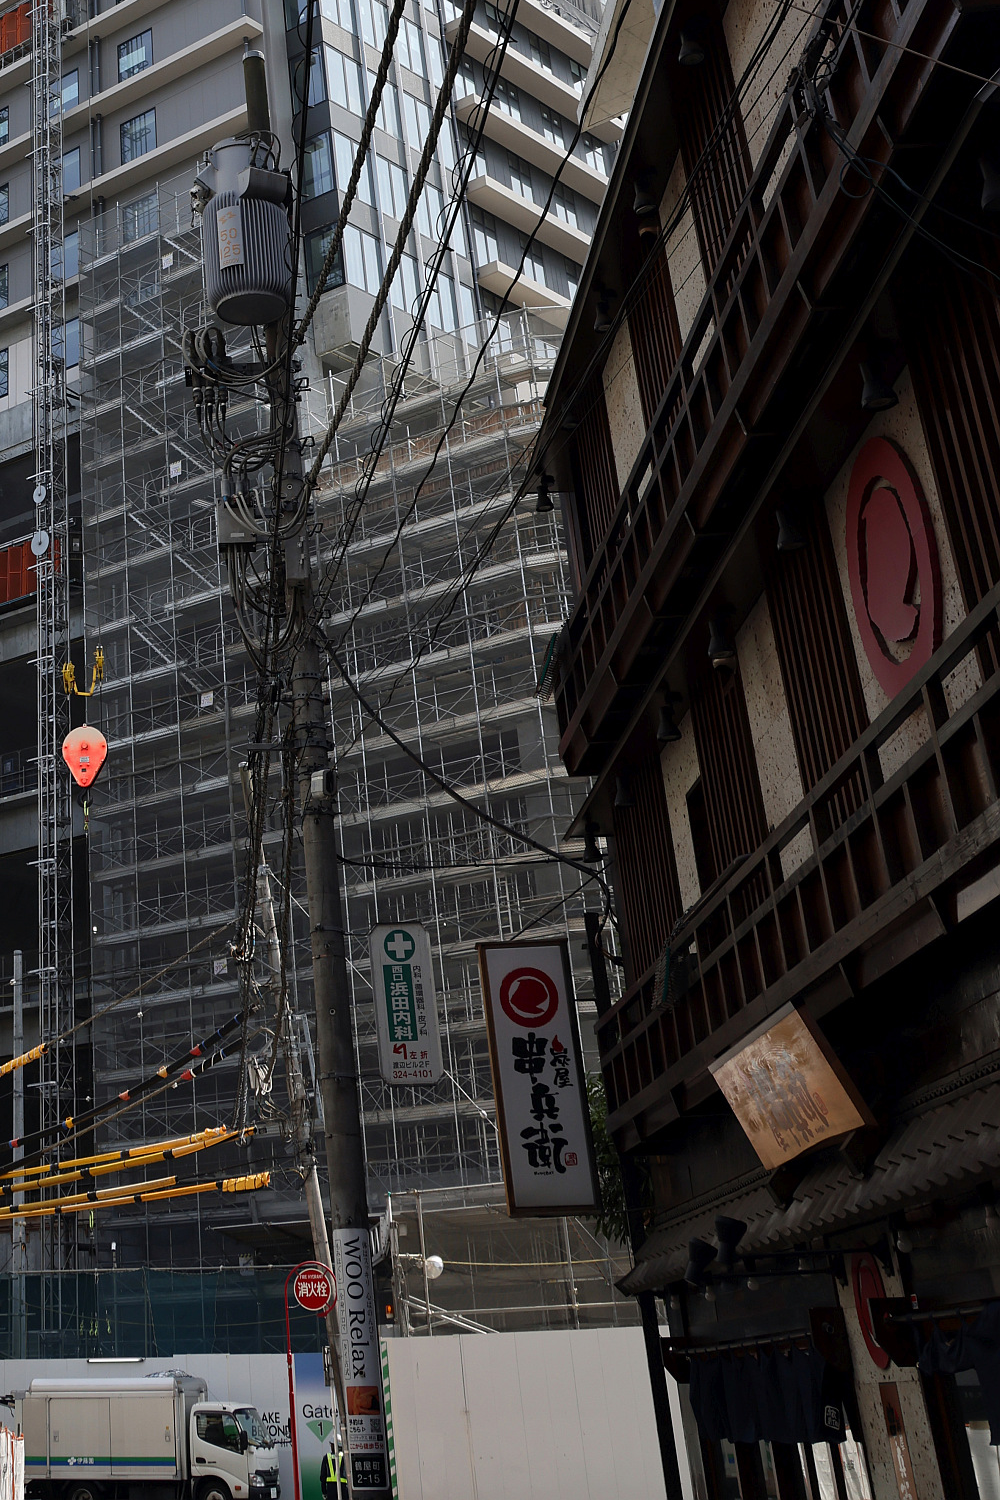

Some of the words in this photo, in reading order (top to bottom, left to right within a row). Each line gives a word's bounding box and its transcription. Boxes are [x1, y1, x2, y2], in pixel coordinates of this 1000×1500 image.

[220, 227, 237, 242] 50
[220, 244, 241, 260] 125
[550, 1037, 574, 1088] 炭屋
[392, 1069, 433, 1079] 324-4101
[343, 1236, 365, 1300] WOO
[297, 1281, 328, 1298] 消火栓
[348, 1308, 370, 1380] Relax
[302, 1404, 339, 1419] Gate
[357, 1473, 381, 1485] 2-15
